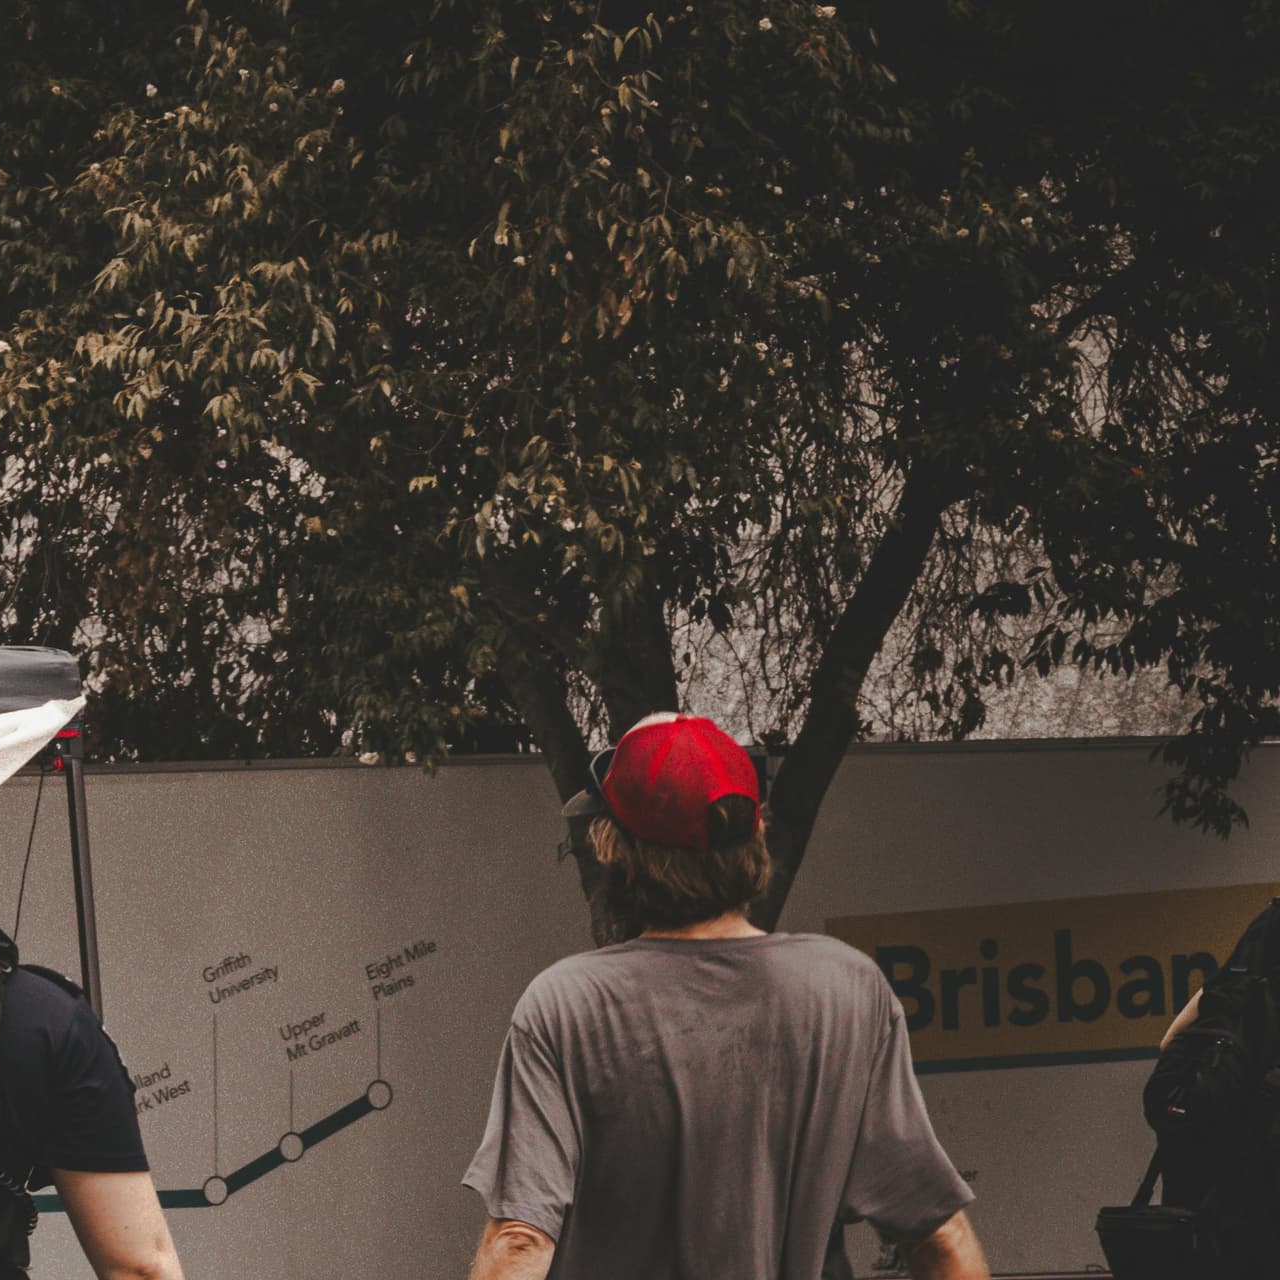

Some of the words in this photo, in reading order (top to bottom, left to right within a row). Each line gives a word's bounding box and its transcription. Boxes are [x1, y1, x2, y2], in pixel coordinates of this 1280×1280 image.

[202, 952, 252, 983] Griffith
[365, 955, 405, 981] Eight
[404, 941, 437, 962] Mile
[208, 965, 279, 1004] University
[372, 975, 416, 1001] Plains
[875, 928, 1222, 1033] Brisban
[280, 1012, 326, 1041] Upper
[286, 1043, 308, 1062] Mt
[308, 1019, 361, 1051] Gravatt
[152, 1080, 192, 1105] West
